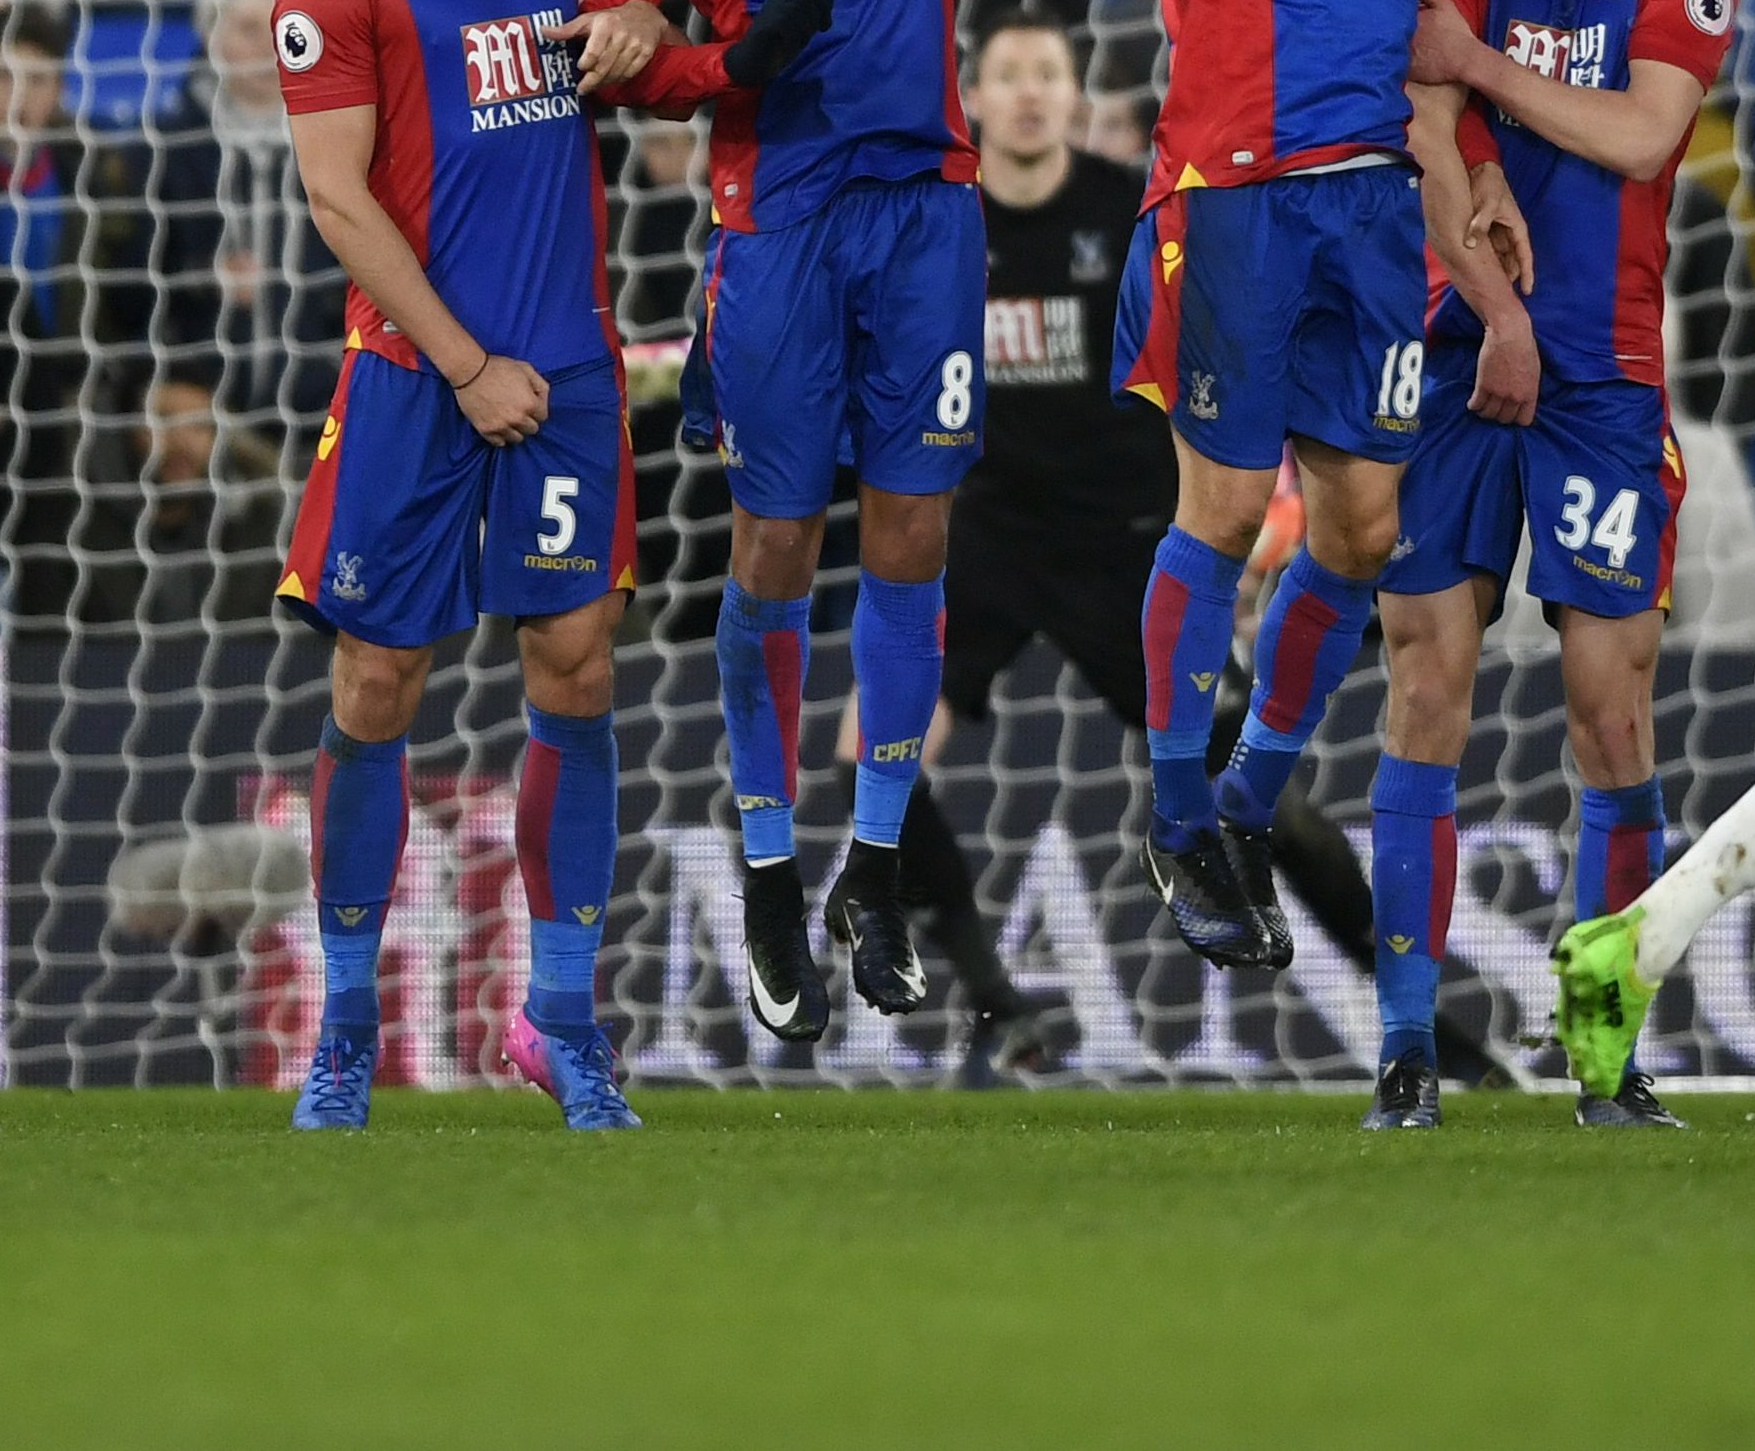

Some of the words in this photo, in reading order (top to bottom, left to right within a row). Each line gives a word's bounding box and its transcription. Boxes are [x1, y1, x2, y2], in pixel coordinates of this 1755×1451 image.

[470, 98, 581, 133] MANSION
[936, 350, 973, 430] 8
[1377, 340, 1424, 419] 18
[536, 475, 579, 555] 5
[1554, 475, 1640, 568] 34
[523, 553, 597, 572] macron
[1572, 554, 1643, 590] macron
[873, 736, 922, 764] CPFC
